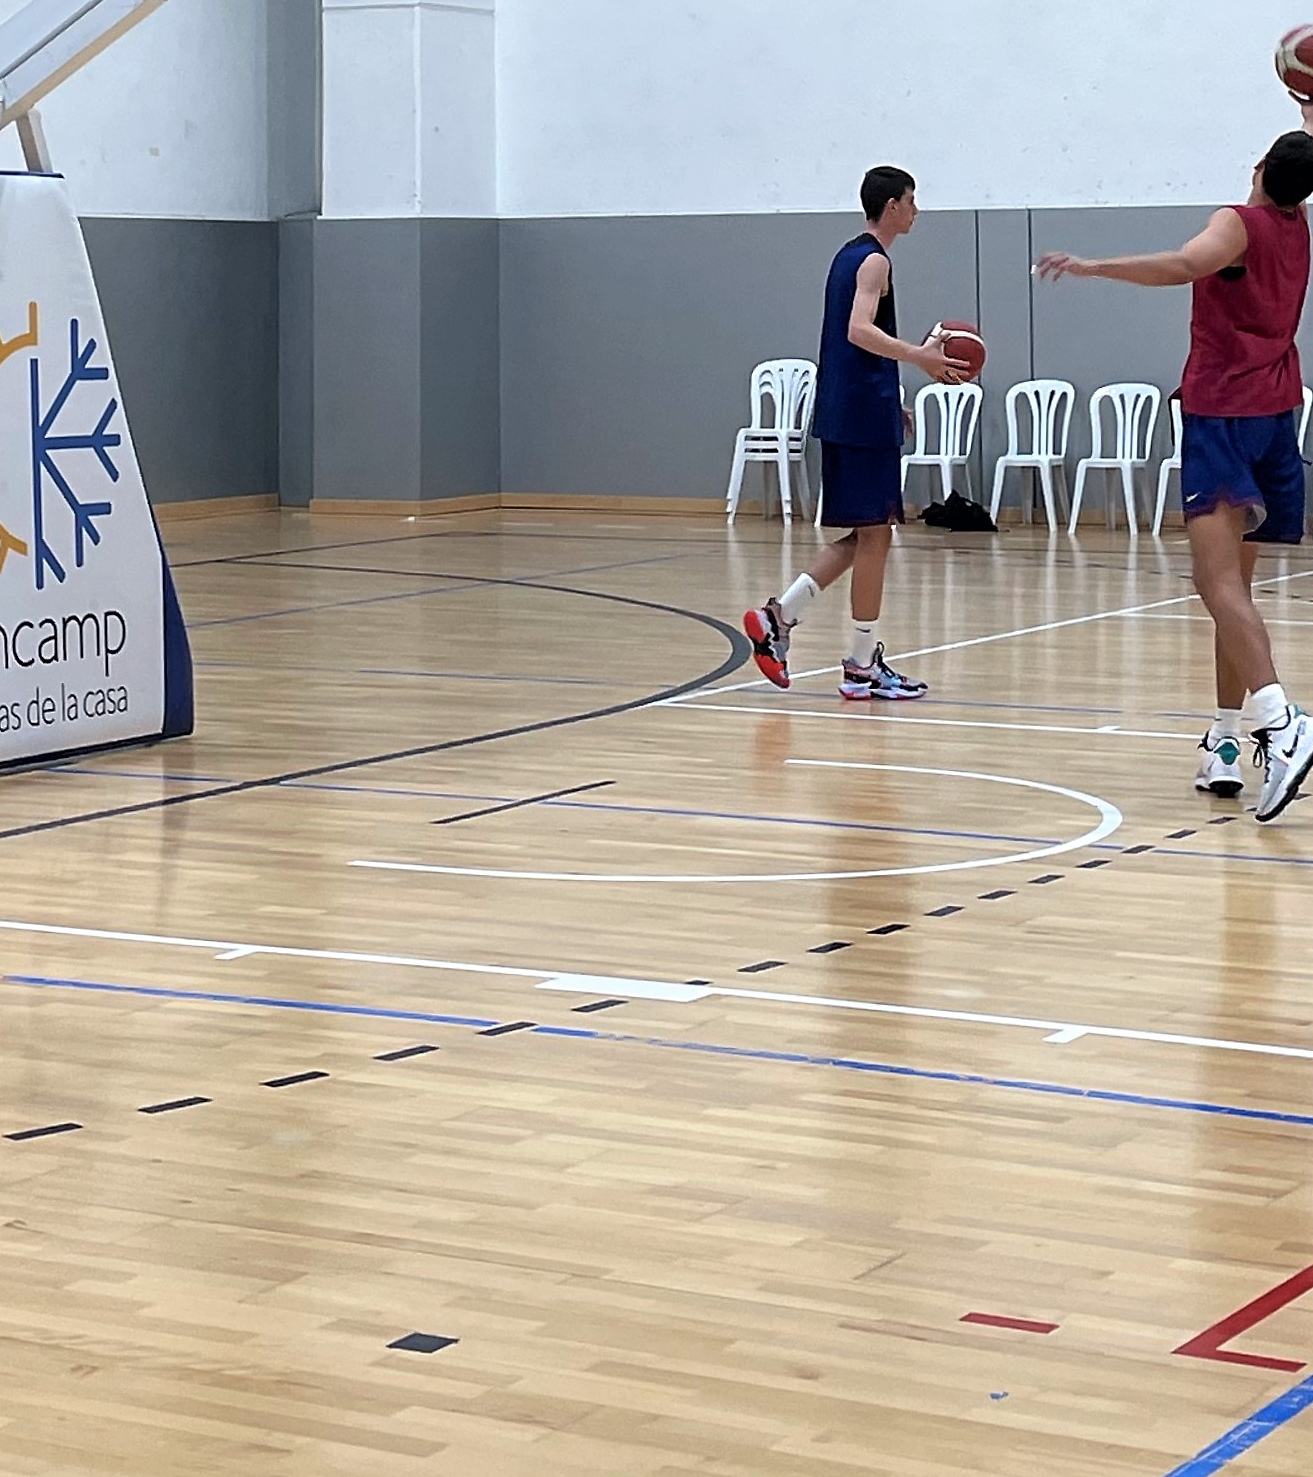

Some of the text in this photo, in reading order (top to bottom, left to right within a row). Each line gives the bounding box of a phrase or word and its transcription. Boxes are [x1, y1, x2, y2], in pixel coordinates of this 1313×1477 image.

[26, 686, 55, 726] de
[61, 682, 79, 722] la
[83, 685, 128, 718] casa
